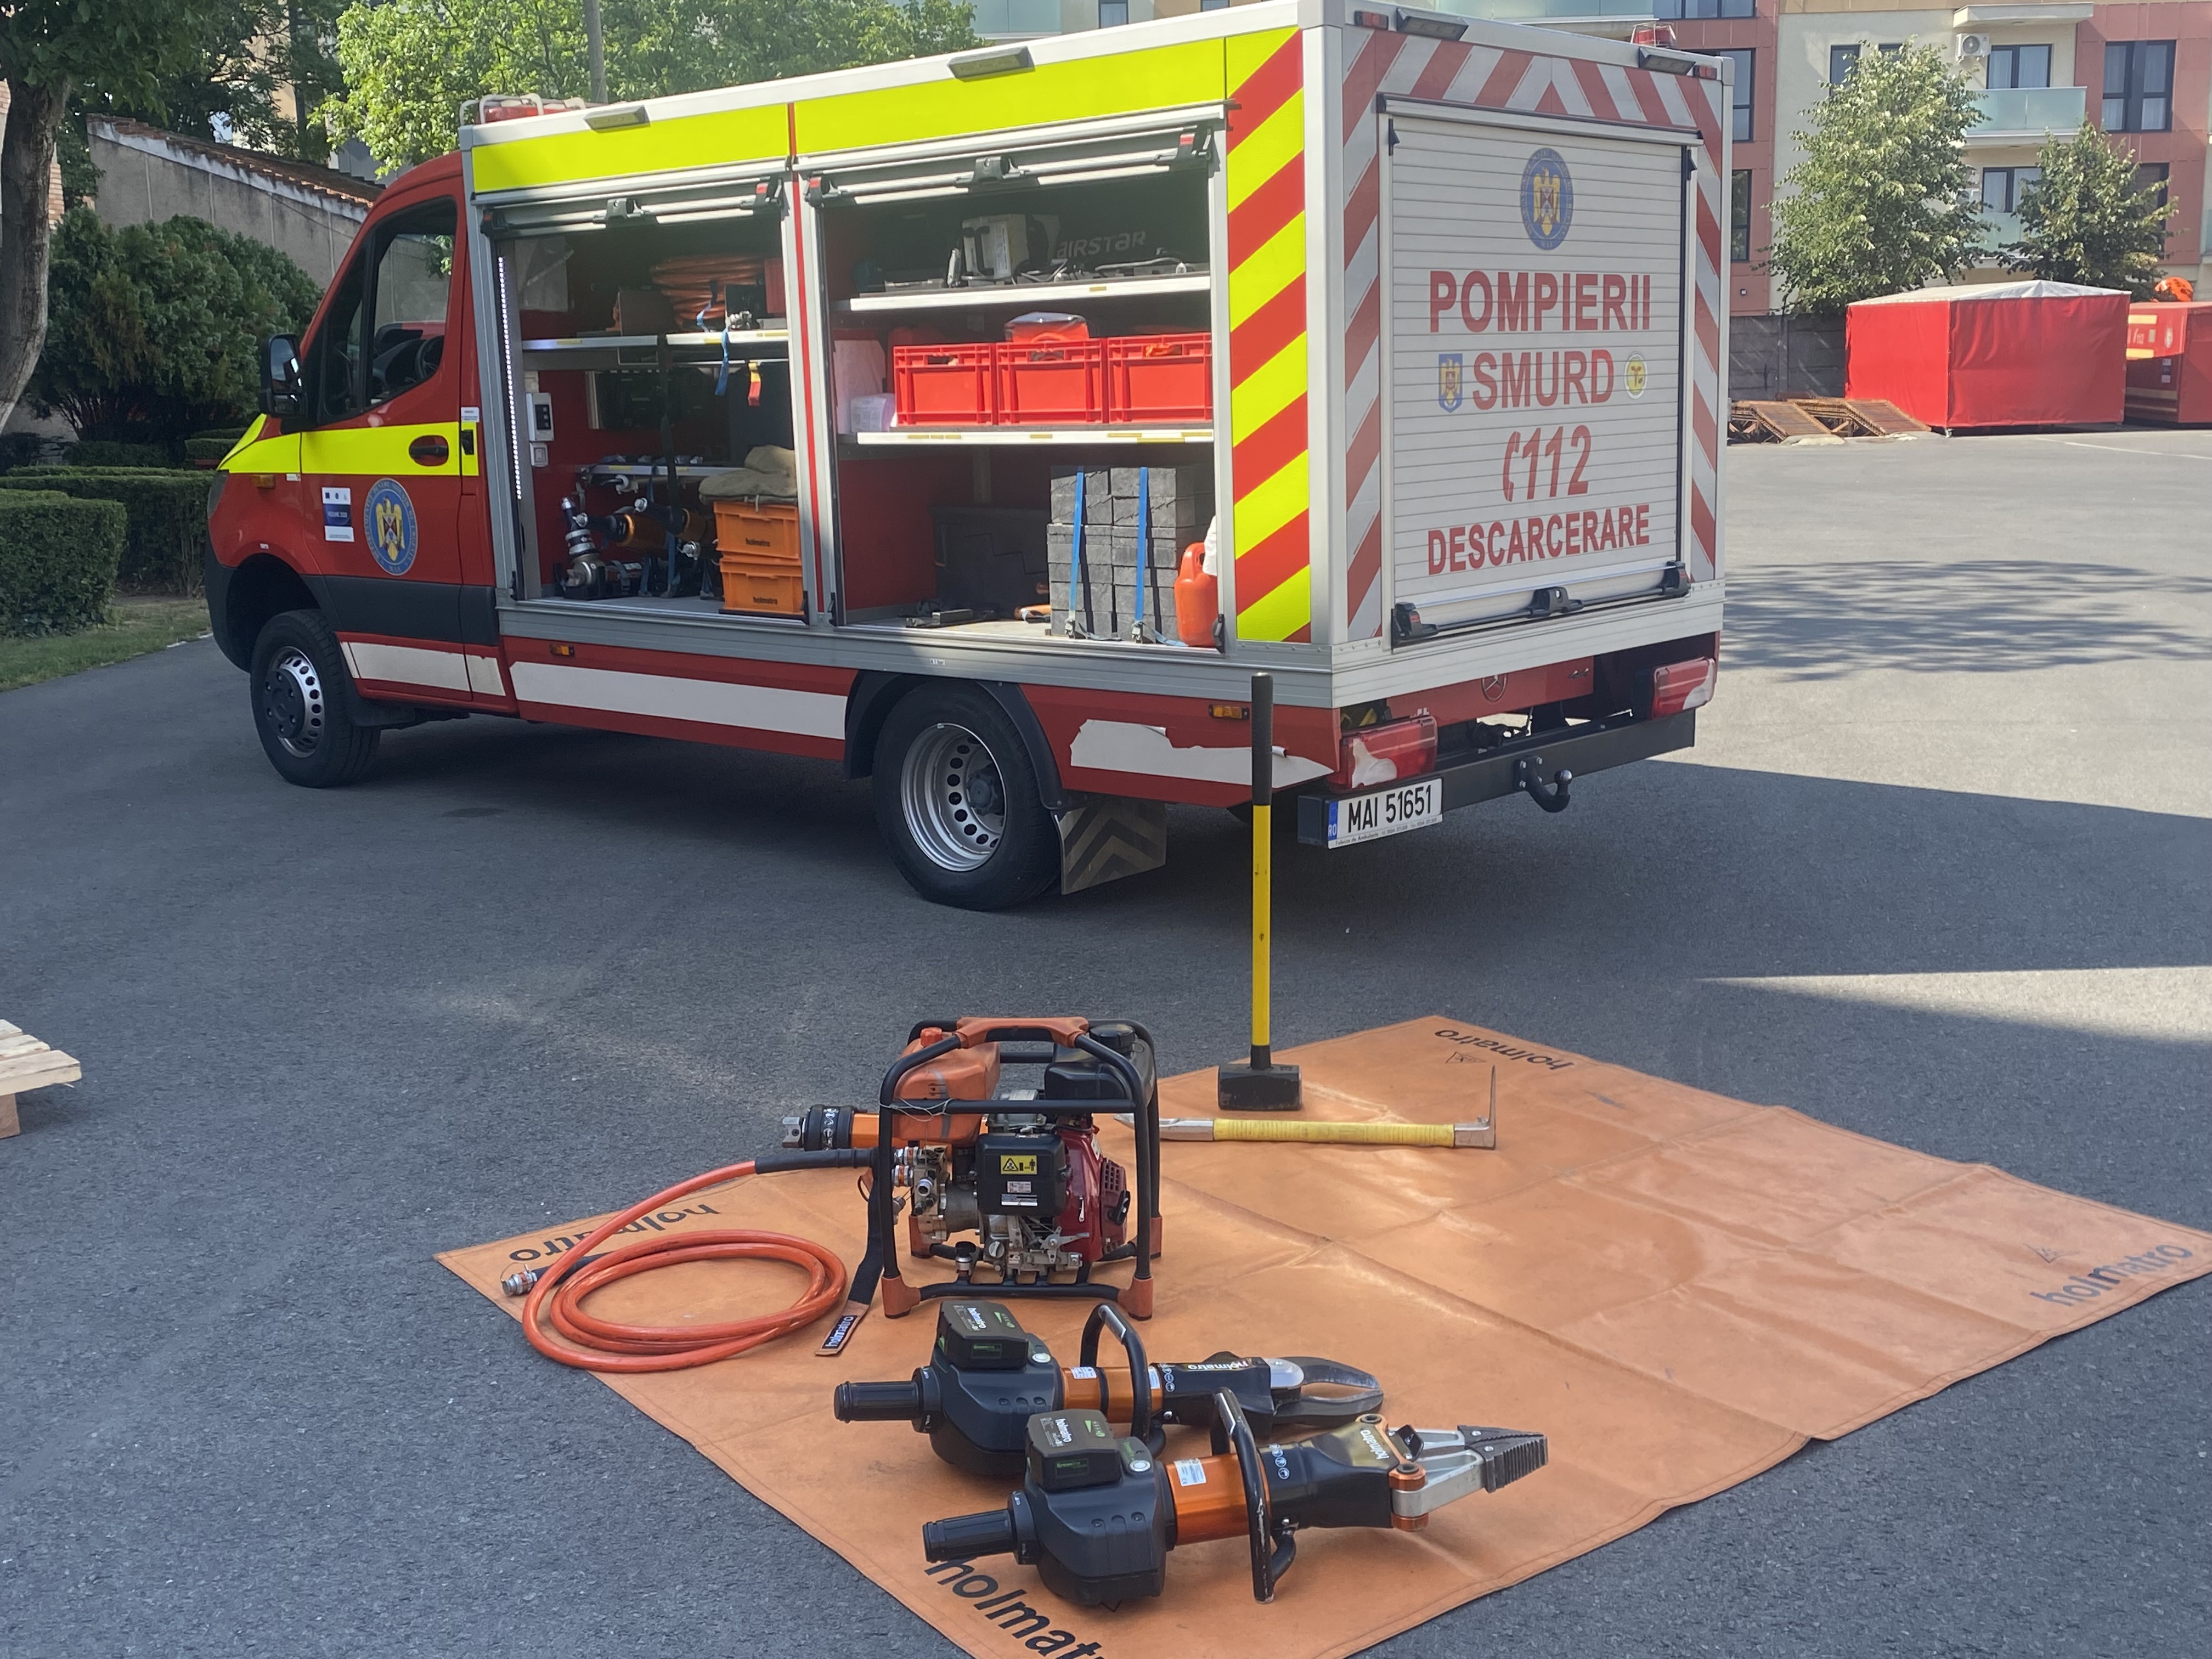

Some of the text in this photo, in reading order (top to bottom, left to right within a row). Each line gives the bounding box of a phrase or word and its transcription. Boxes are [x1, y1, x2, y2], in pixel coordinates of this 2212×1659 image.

[1430, 270, 1650, 332] POMPIERII
[1472, 349, 1614, 410] SMURD
[1522, 425, 1592, 499] 112
[1428, 504, 1650, 575] DESCARCERARE
[1328, 823, 1337, 837] RO
[1348, 785, 1431, 833] MAI 51651
[1435, 1029, 1574, 1070] holmatro
[509, 1204, 721, 1261] holmtro
[2029, 1244, 2193, 1307] holmatro
[825, 1316, 854, 1347] holmatro
[1188, 1359, 1249, 1371] holmatro
[1360, 1429, 1390, 1459] holmatro
[924, 1557, 1104, 1659] holmat
